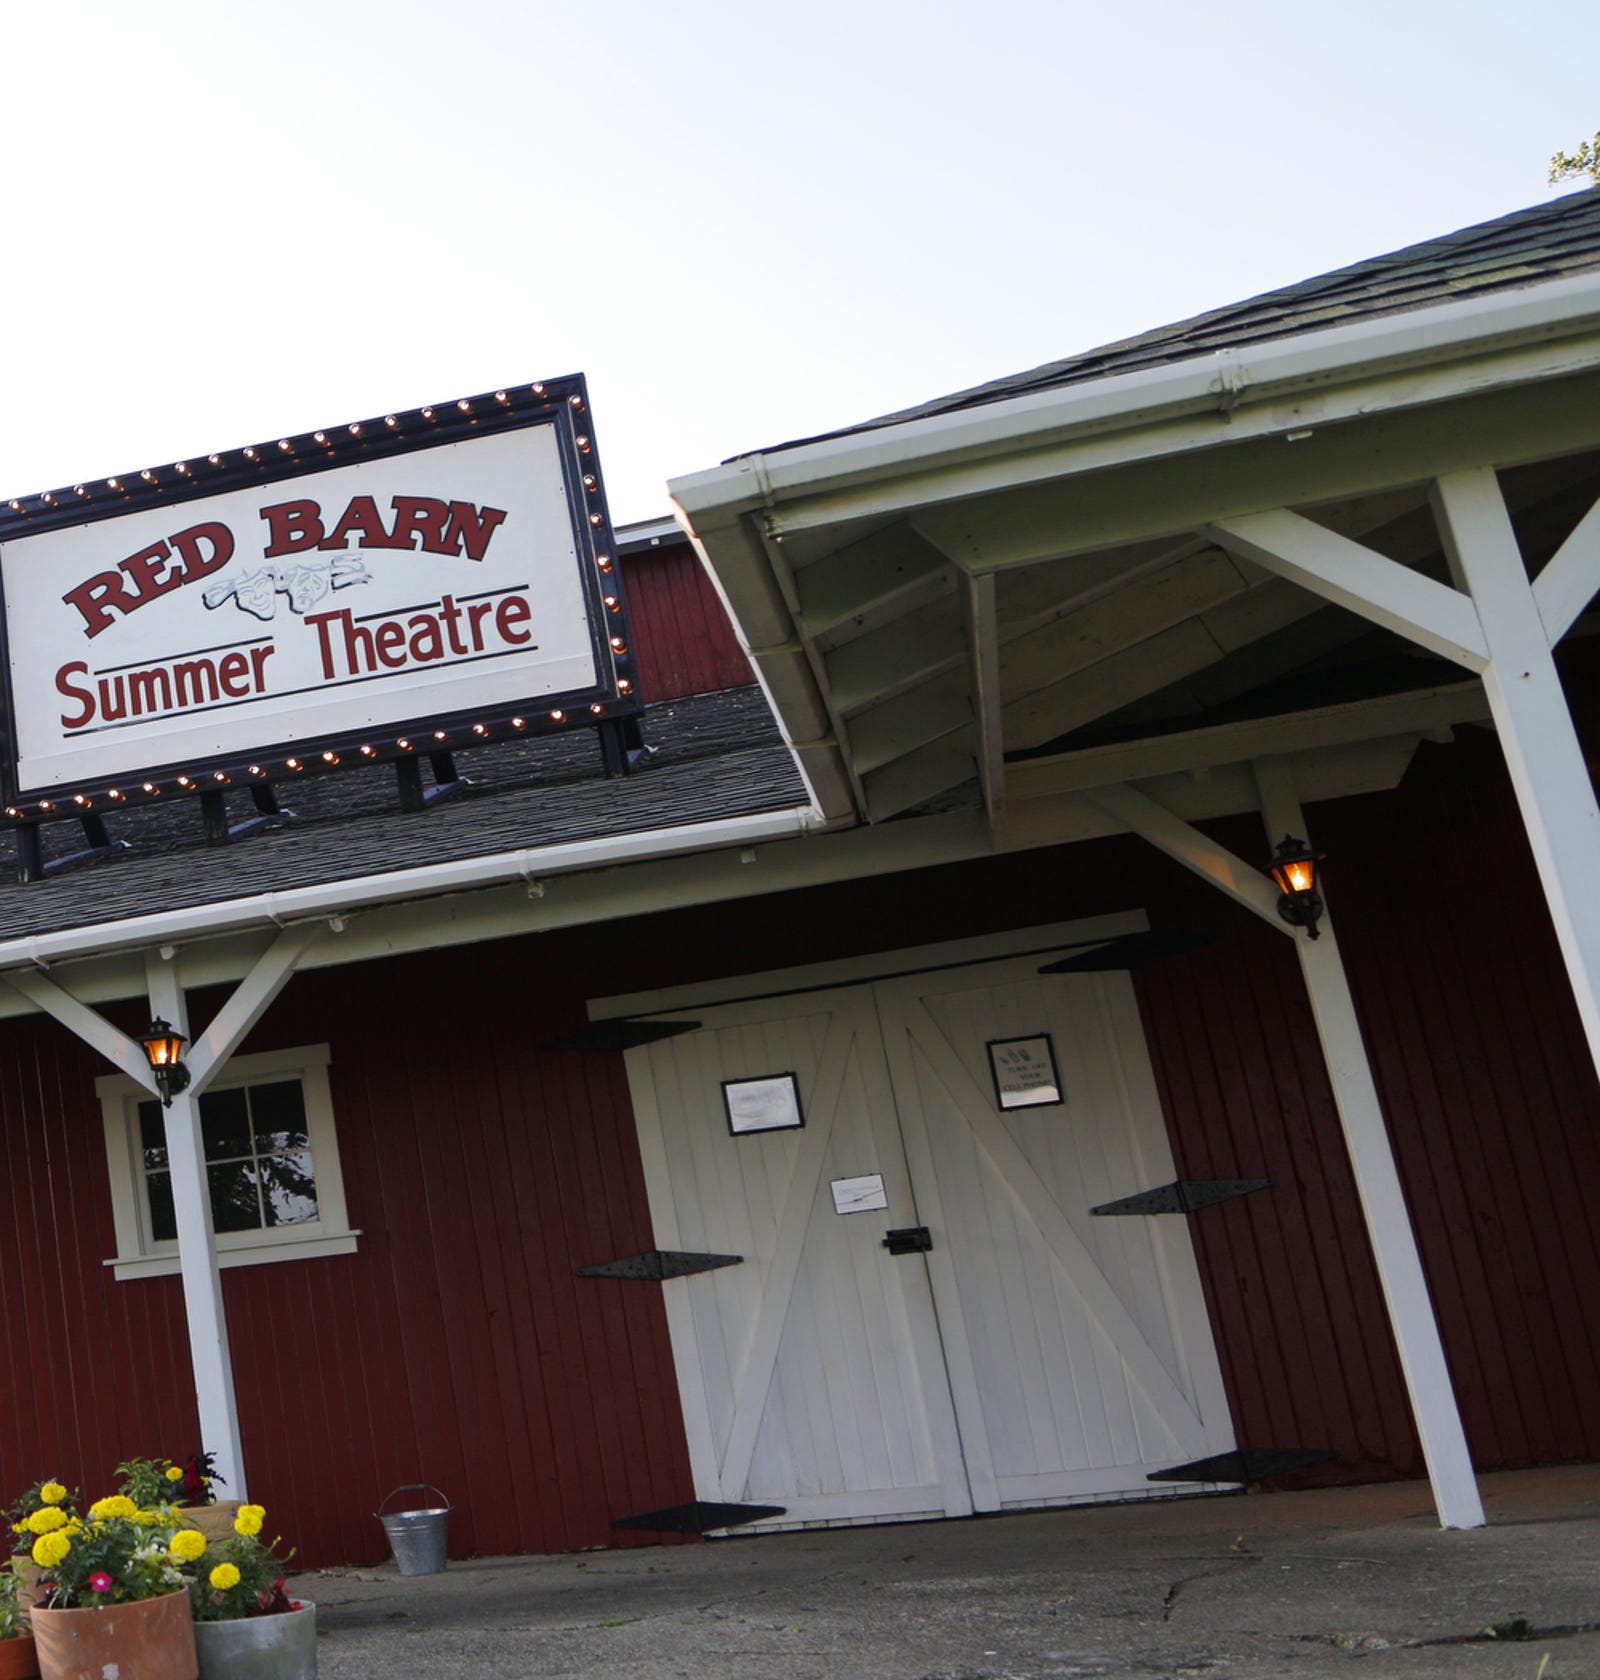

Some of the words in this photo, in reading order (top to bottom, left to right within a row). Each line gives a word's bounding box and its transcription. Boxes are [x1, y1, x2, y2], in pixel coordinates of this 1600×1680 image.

[61, 520, 236, 639] RED
[259, 495, 508, 561] BARN
[54, 644, 276, 730] Summer
[304, 593, 533, 680] Theatre
